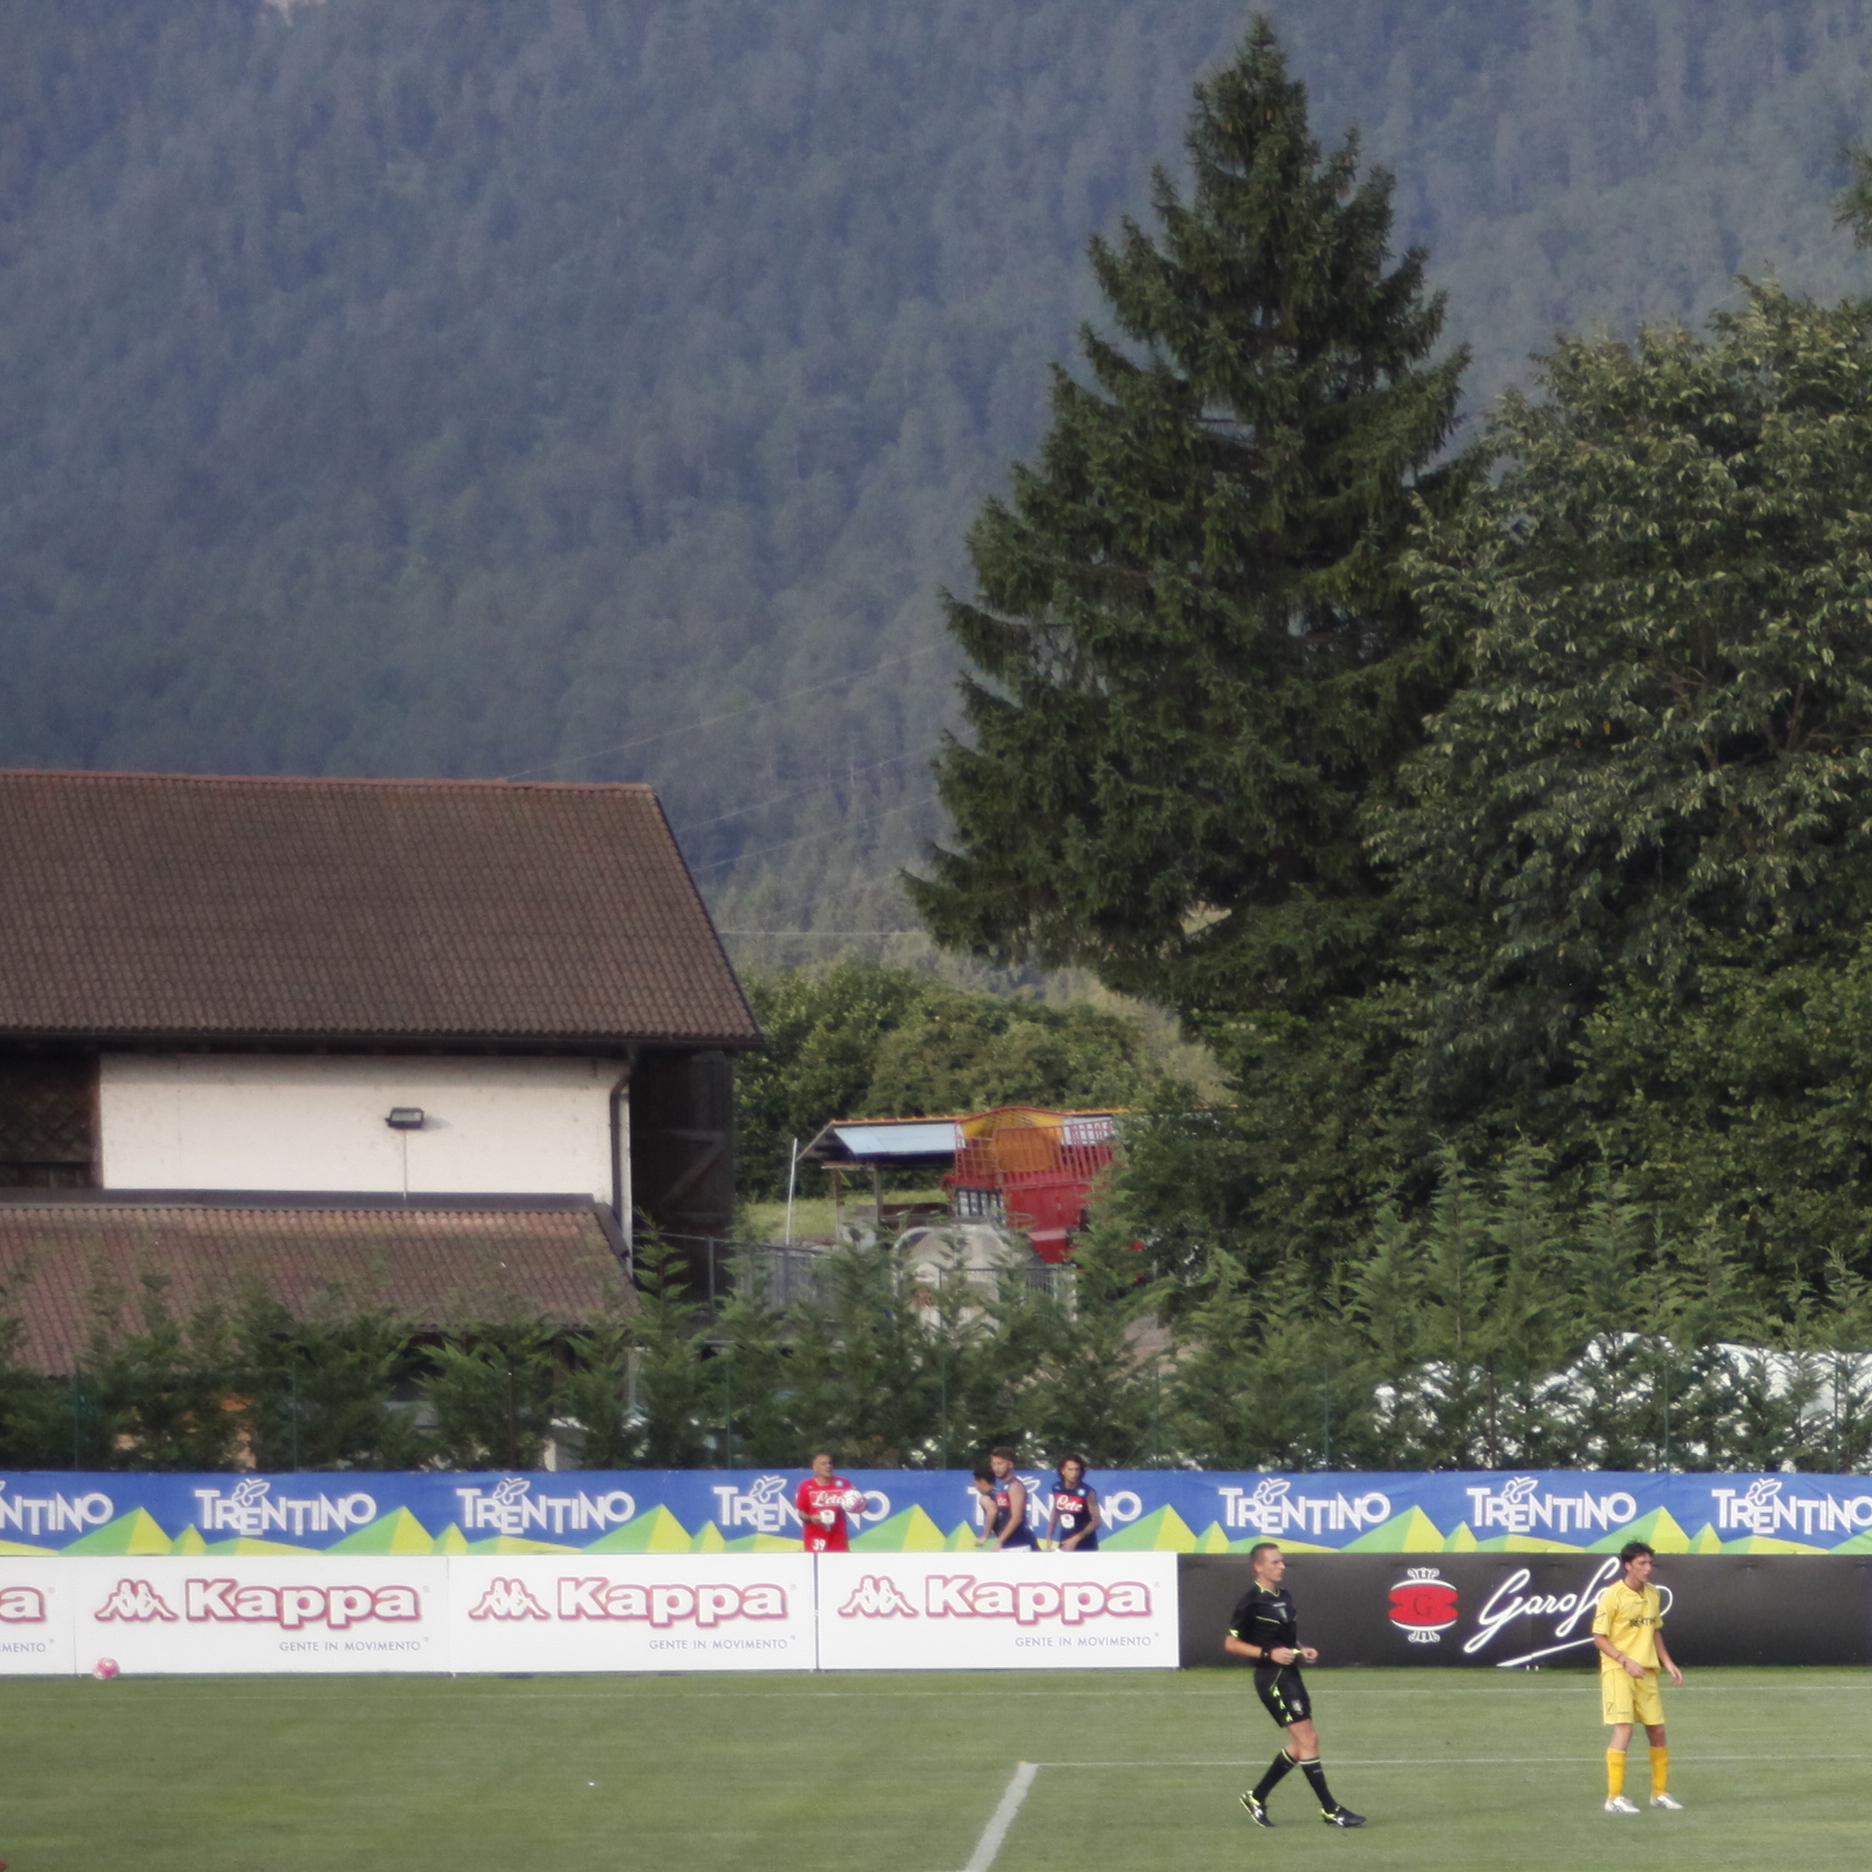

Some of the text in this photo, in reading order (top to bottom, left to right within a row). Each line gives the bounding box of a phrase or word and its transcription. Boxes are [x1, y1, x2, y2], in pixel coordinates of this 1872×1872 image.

[195, 1488, 378, 1536] TRENTINO
[455, 1487, 637, 1535] TRENTINO
[712, 1485, 891, 1532] TRENO
[1218, 1486, 1392, 1535] TRENTINO
[1466, 1486, 1638, 1533] TRENTINO
[185, 1578, 422, 1630] Kappa
[557, 1577, 788, 1628] Kappa
[926, 1575, 1153, 1626] Kappa
[279, 1640, 422, 1652] GENTE IN MOVIMENTO
[648, 1638, 788, 1650] GENTE IN MOVIMENTO
[1014, 1636, 1152, 1648] GENTE IN MOVIMENTO
